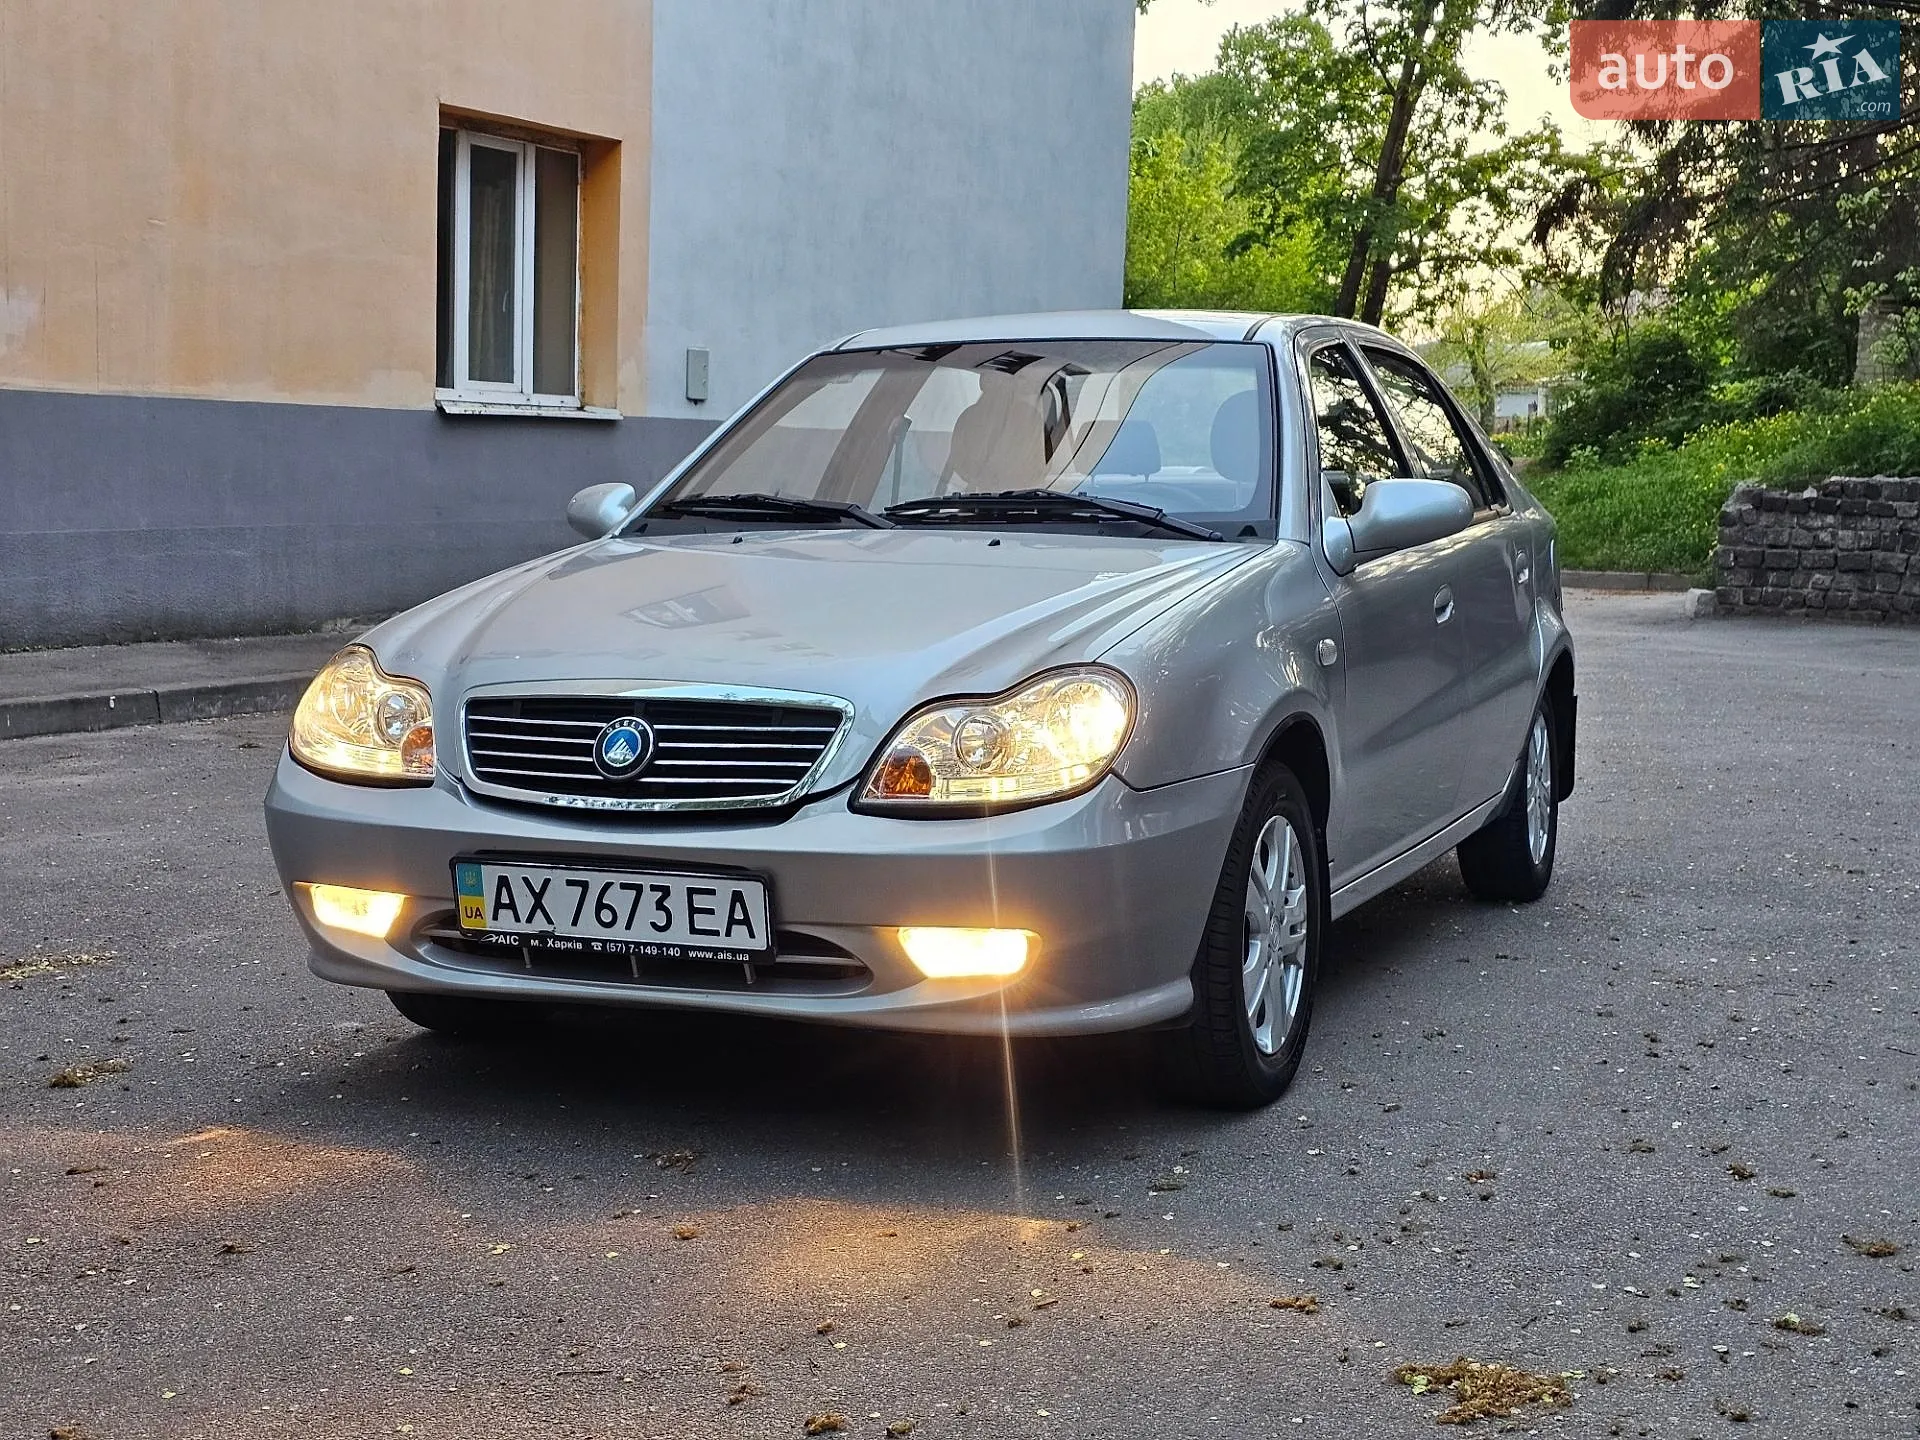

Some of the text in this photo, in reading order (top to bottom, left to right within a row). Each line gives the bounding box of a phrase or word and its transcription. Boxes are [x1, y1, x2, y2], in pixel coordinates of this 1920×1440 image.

[464, 905, 484, 920] UA
[491, 874, 756, 939] AX 7673 EA
[546, 937, 583, 950] Харків
[606, 941, 626, 954] (57)
[628, 944, 681, 957] 7-149-140
[688, 949, 750, 961] www.ais.ua
